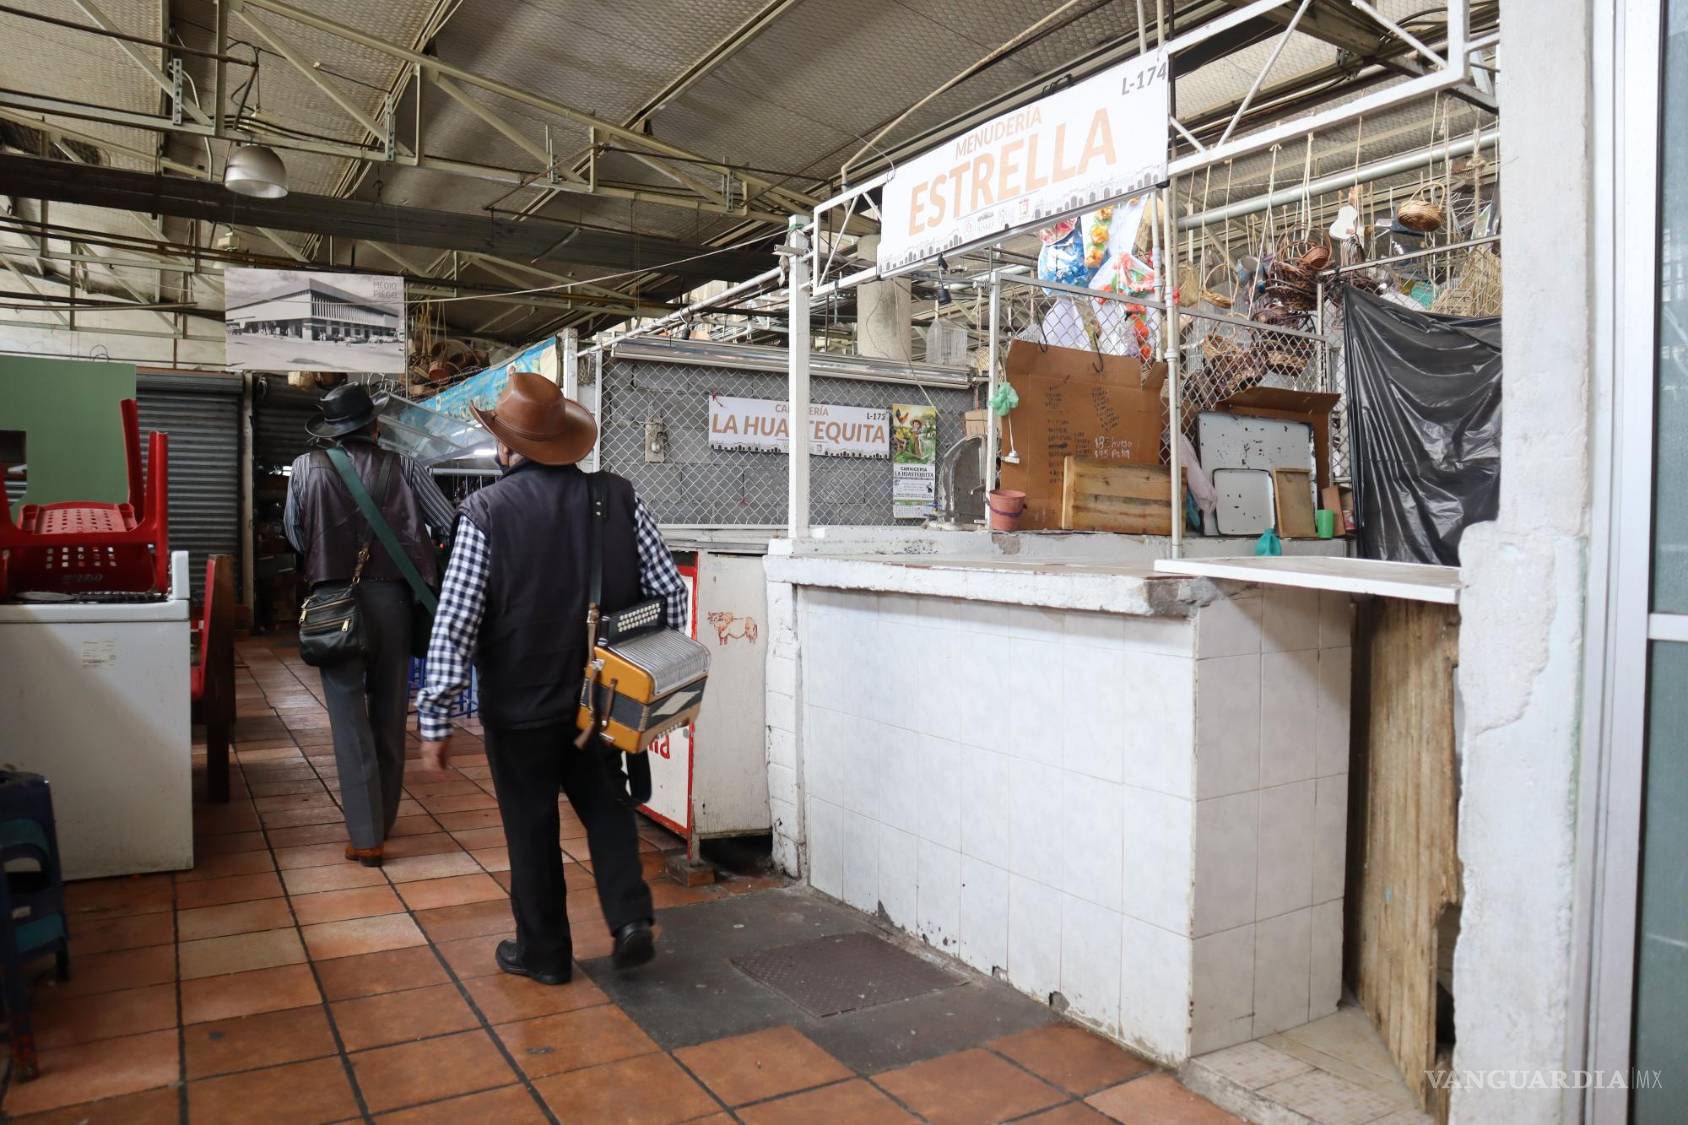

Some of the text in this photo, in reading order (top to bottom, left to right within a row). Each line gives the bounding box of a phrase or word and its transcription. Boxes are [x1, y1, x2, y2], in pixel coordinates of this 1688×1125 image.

[1122, 62, 1167, 95] L-174
[955, 106, 1042, 159] MENUDERÍA
[908, 107, 1117, 237] ESTRELLA
[712, 413, 885, 444] LA HUAEQUITA
